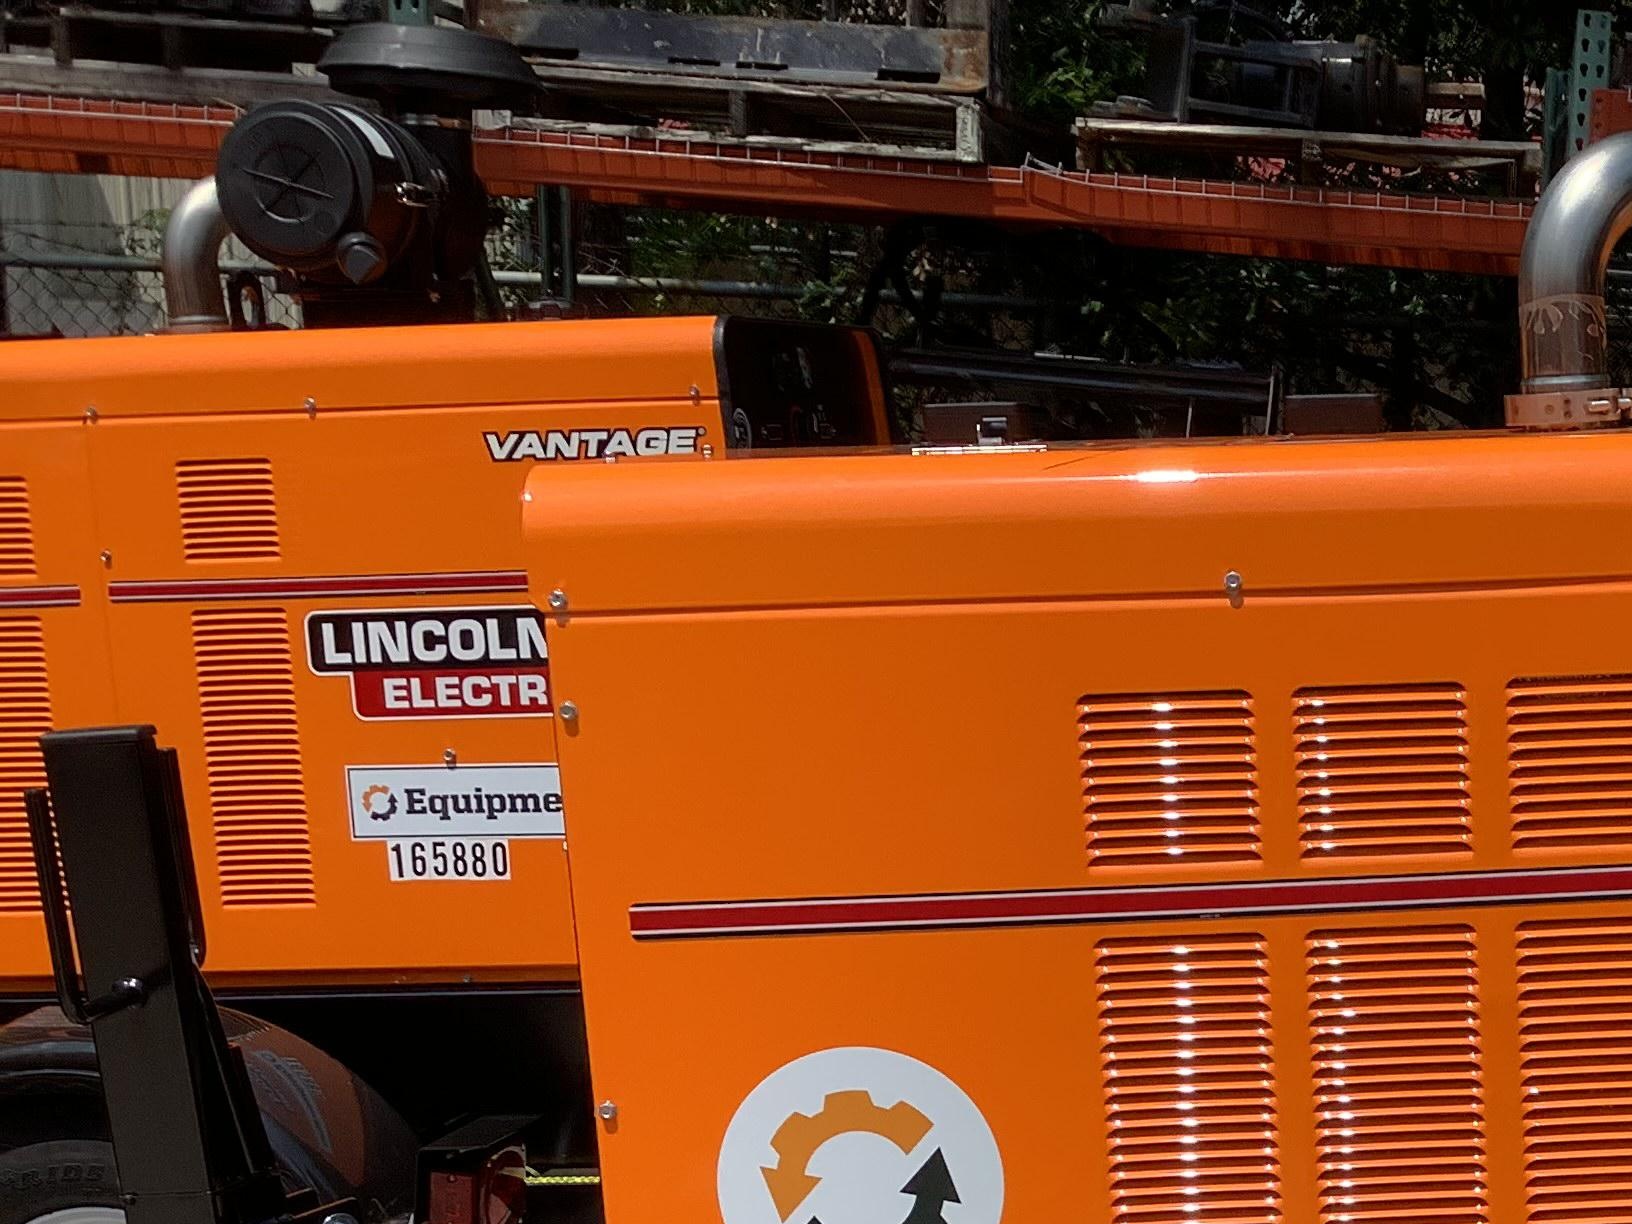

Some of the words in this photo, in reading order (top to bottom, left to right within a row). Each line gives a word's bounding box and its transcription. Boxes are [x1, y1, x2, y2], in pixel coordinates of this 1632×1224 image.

[484, 428, 698, 461] VANTAGE
[383, 674, 548, 709] ELECTR
[391, 841, 509, 878] 165880
